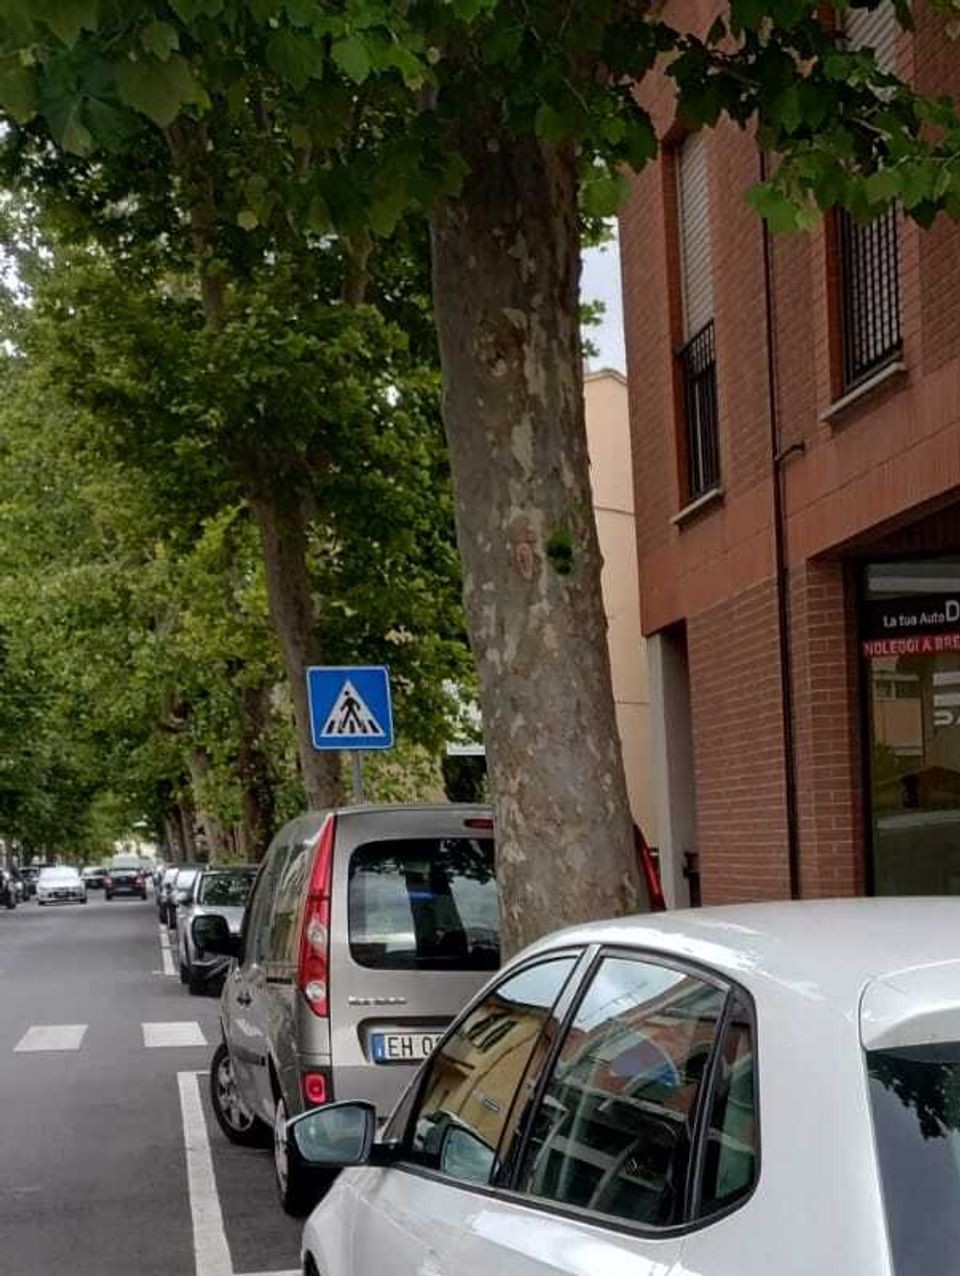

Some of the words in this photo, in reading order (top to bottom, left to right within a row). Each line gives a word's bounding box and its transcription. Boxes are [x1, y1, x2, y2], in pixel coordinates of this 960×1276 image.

[883, 615, 897, 628] La
[899, 612, 917, 626] tua
[920, 611, 945, 625] Auto
[922, 636, 932, 652] A
[387, 1036, 413, 1057] EH
